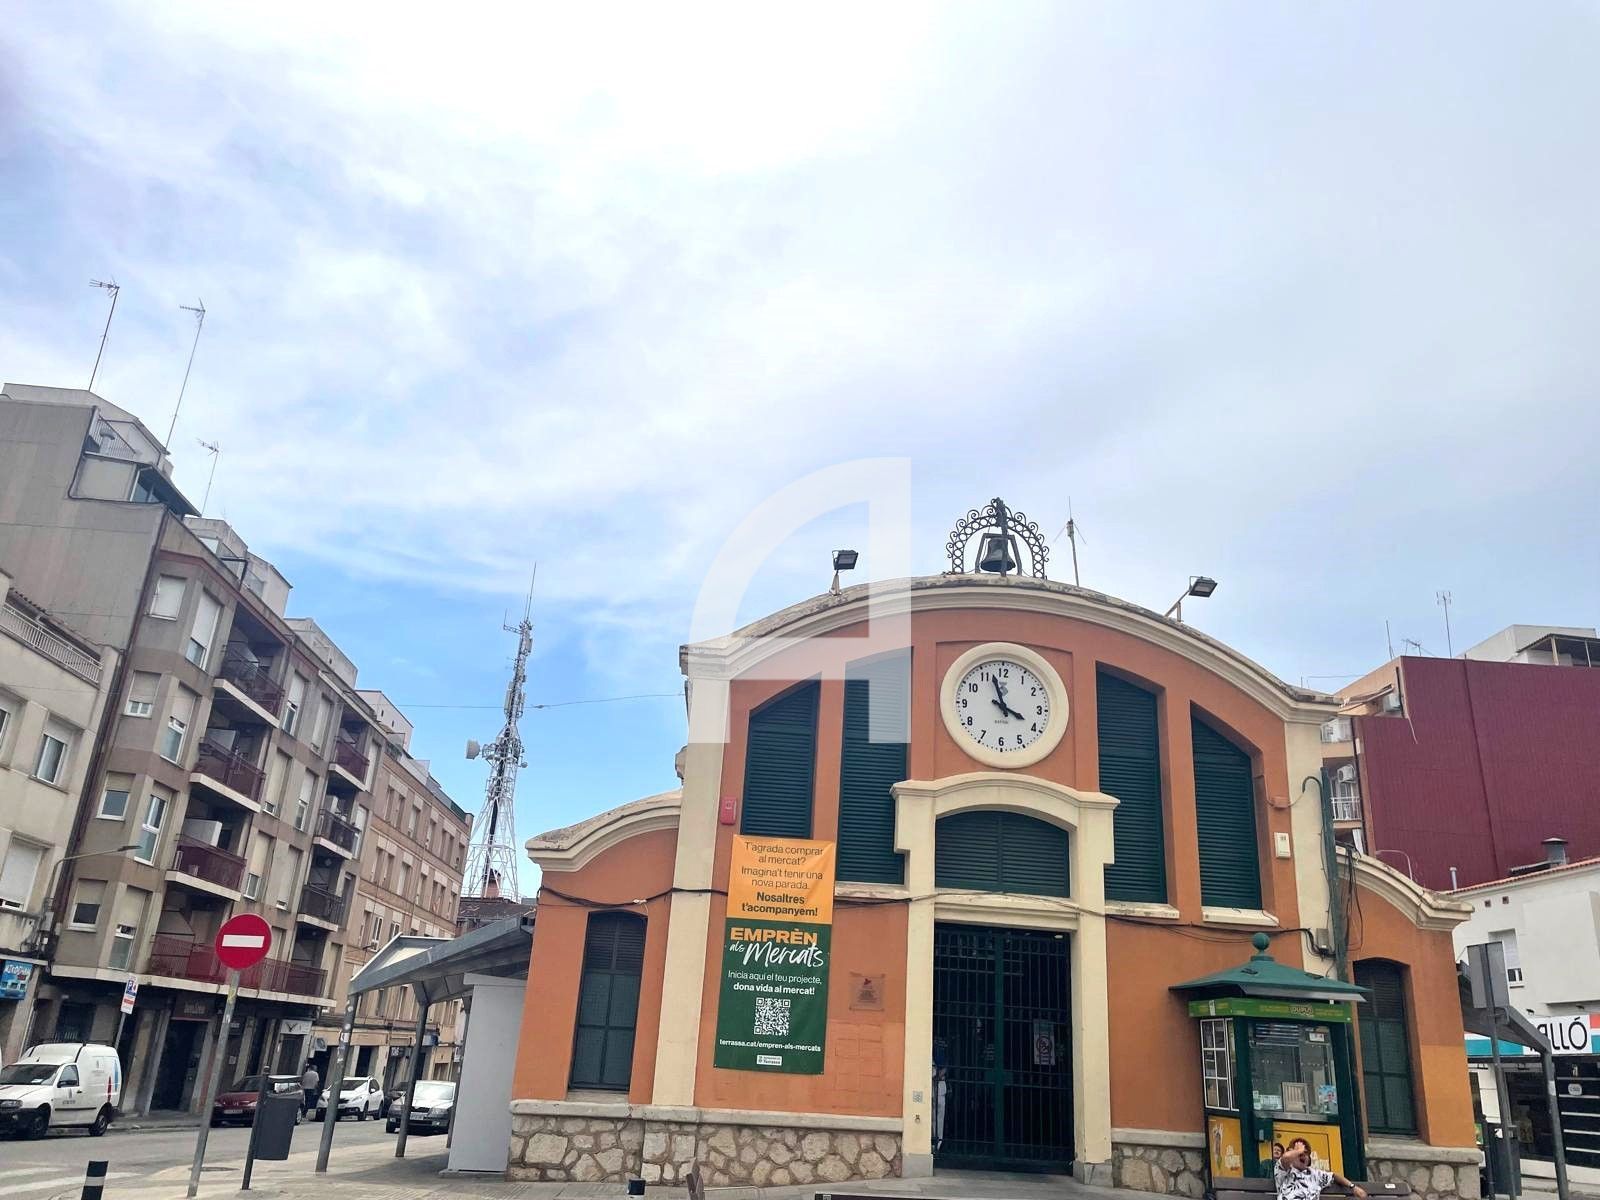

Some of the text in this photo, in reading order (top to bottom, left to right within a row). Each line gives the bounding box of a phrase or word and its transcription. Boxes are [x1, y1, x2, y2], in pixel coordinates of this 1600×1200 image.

[981, 672, 989, 681] 11
[999, 668, 1008, 678] 12
[968, 683, 978, 692] 10
[1031, 688, 1036, 697] 2
[962, 699, 968, 708] 9
[1036, 706, 1043, 715] 3
[967, 716, 973, 726] 8
[1031, 723, 1037, 732] 4
[980, 730, 986, 739] 7
[1017, 735, 1023, 744] 5
[999, 737, 1004, 746] 6
[745, 841, 824, 856] T'agrada comprar
[758, 855, 807, 866] al mercat?
[741, 866, 823, 880] Imagina't tenir una
[751, 879, 810, 890] nova parada.
[756, 891, 805, 904] Nosaltres
[741, 903, 818, 916] t'acompanyem!
[729, 941, 824, 968] als Mercats
[728, 970, 748, 979] Inicia
[775, 974, 788, 982] teu
[788, 975, 822, 984] projecte,
[733, 982, 755, 991] dona
[755, 983, 774, 993] vida
[783, 986, 815, 995] mercat!
